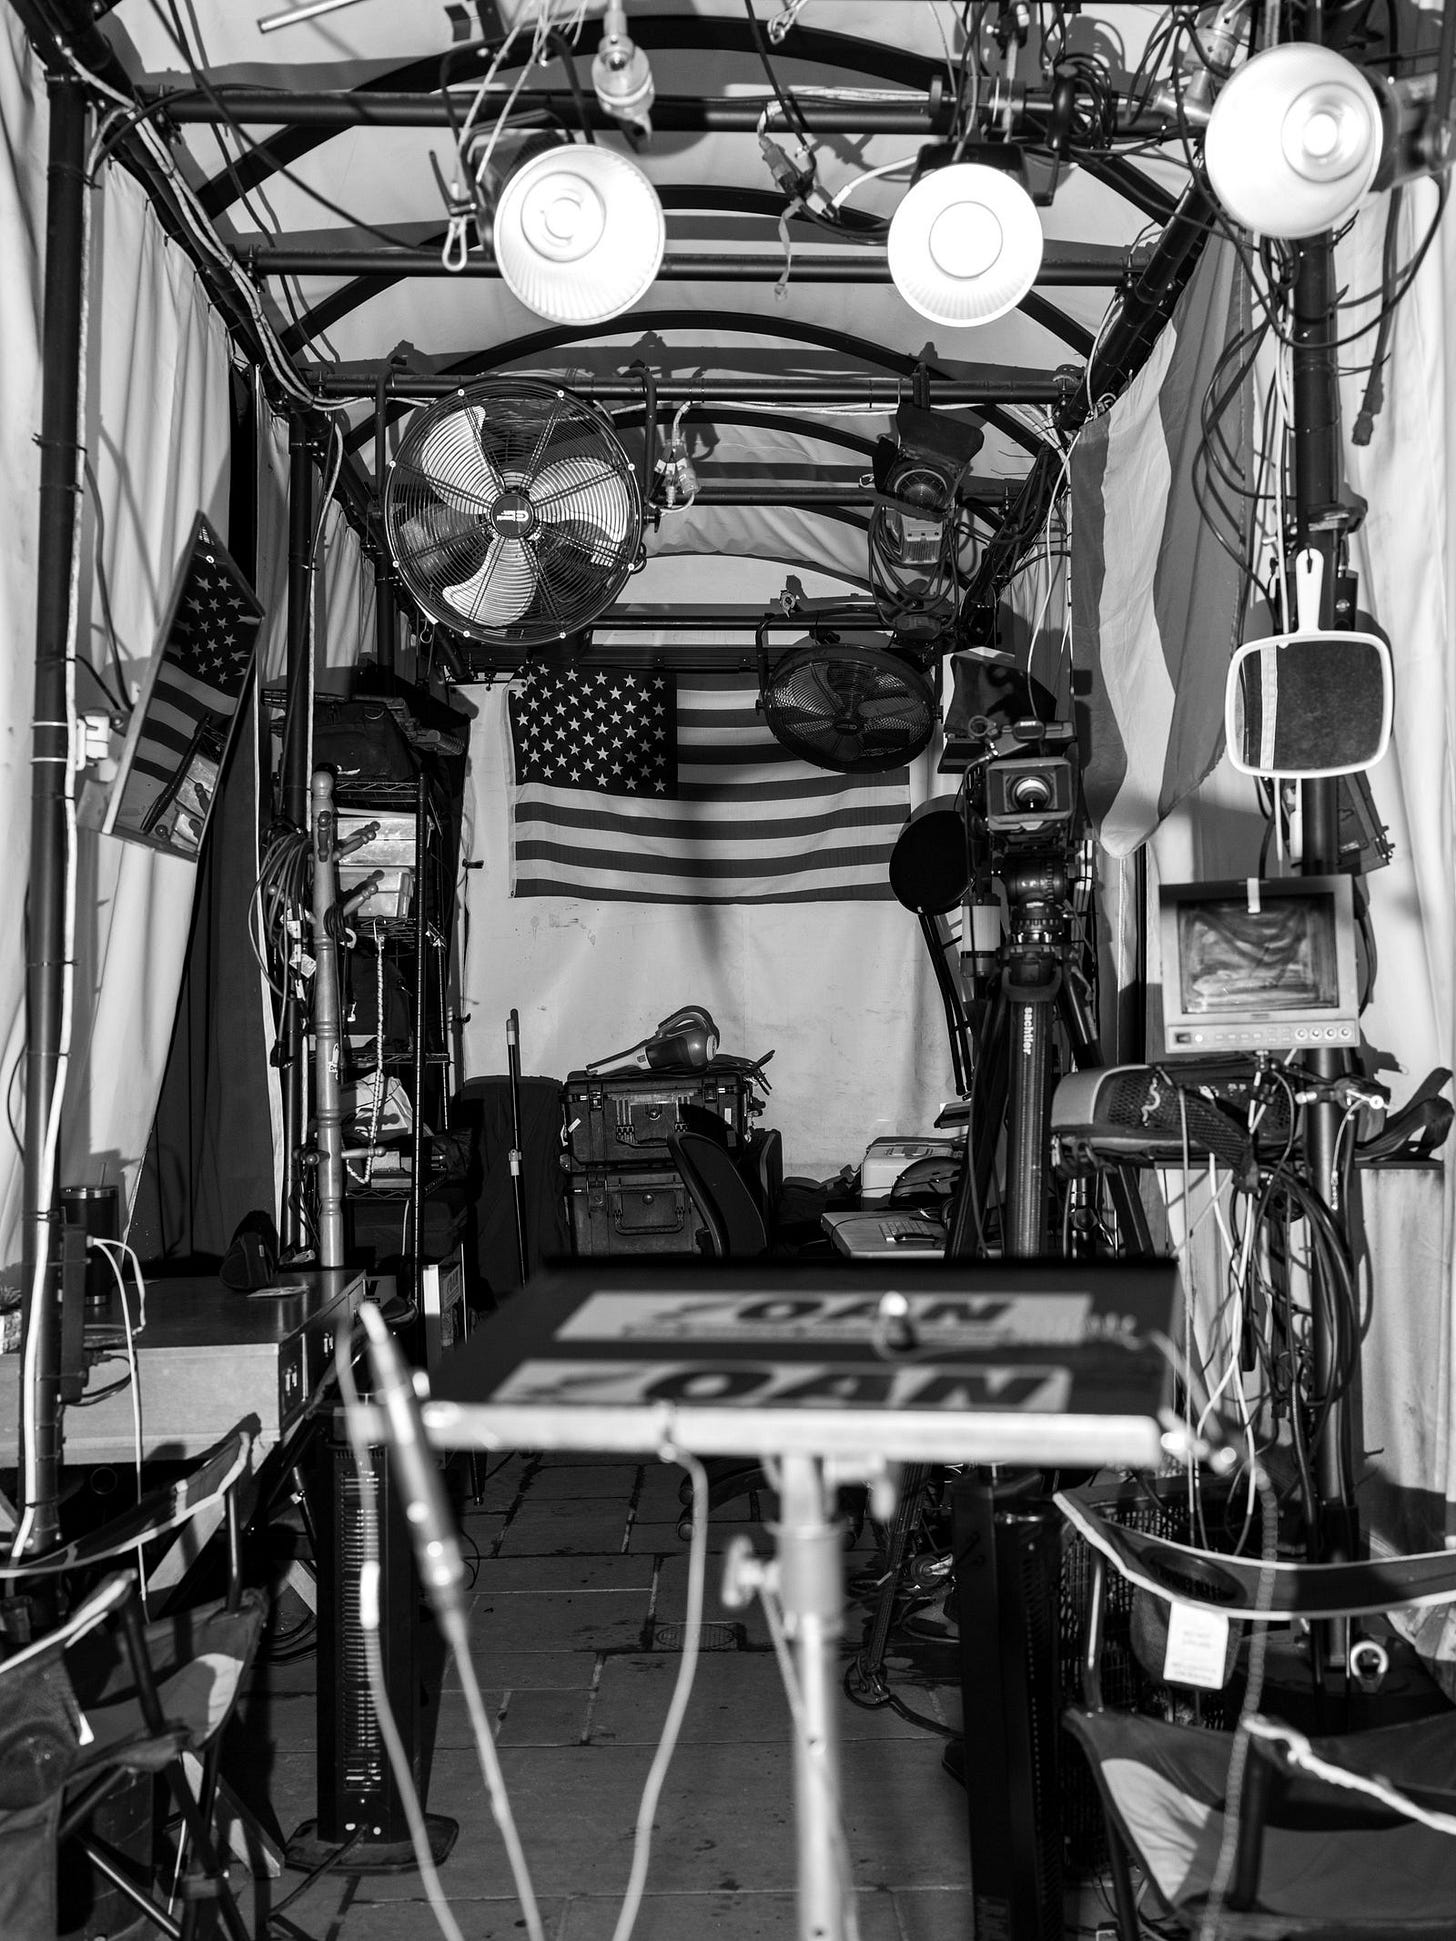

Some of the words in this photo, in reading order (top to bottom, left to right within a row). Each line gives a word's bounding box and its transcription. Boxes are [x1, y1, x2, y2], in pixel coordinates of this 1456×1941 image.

[1023, 1006, 1034, 1056] sachtler
[736, 1296, 1015, 1323] OAN
[643, 1364, 1054, 1408] OAN
